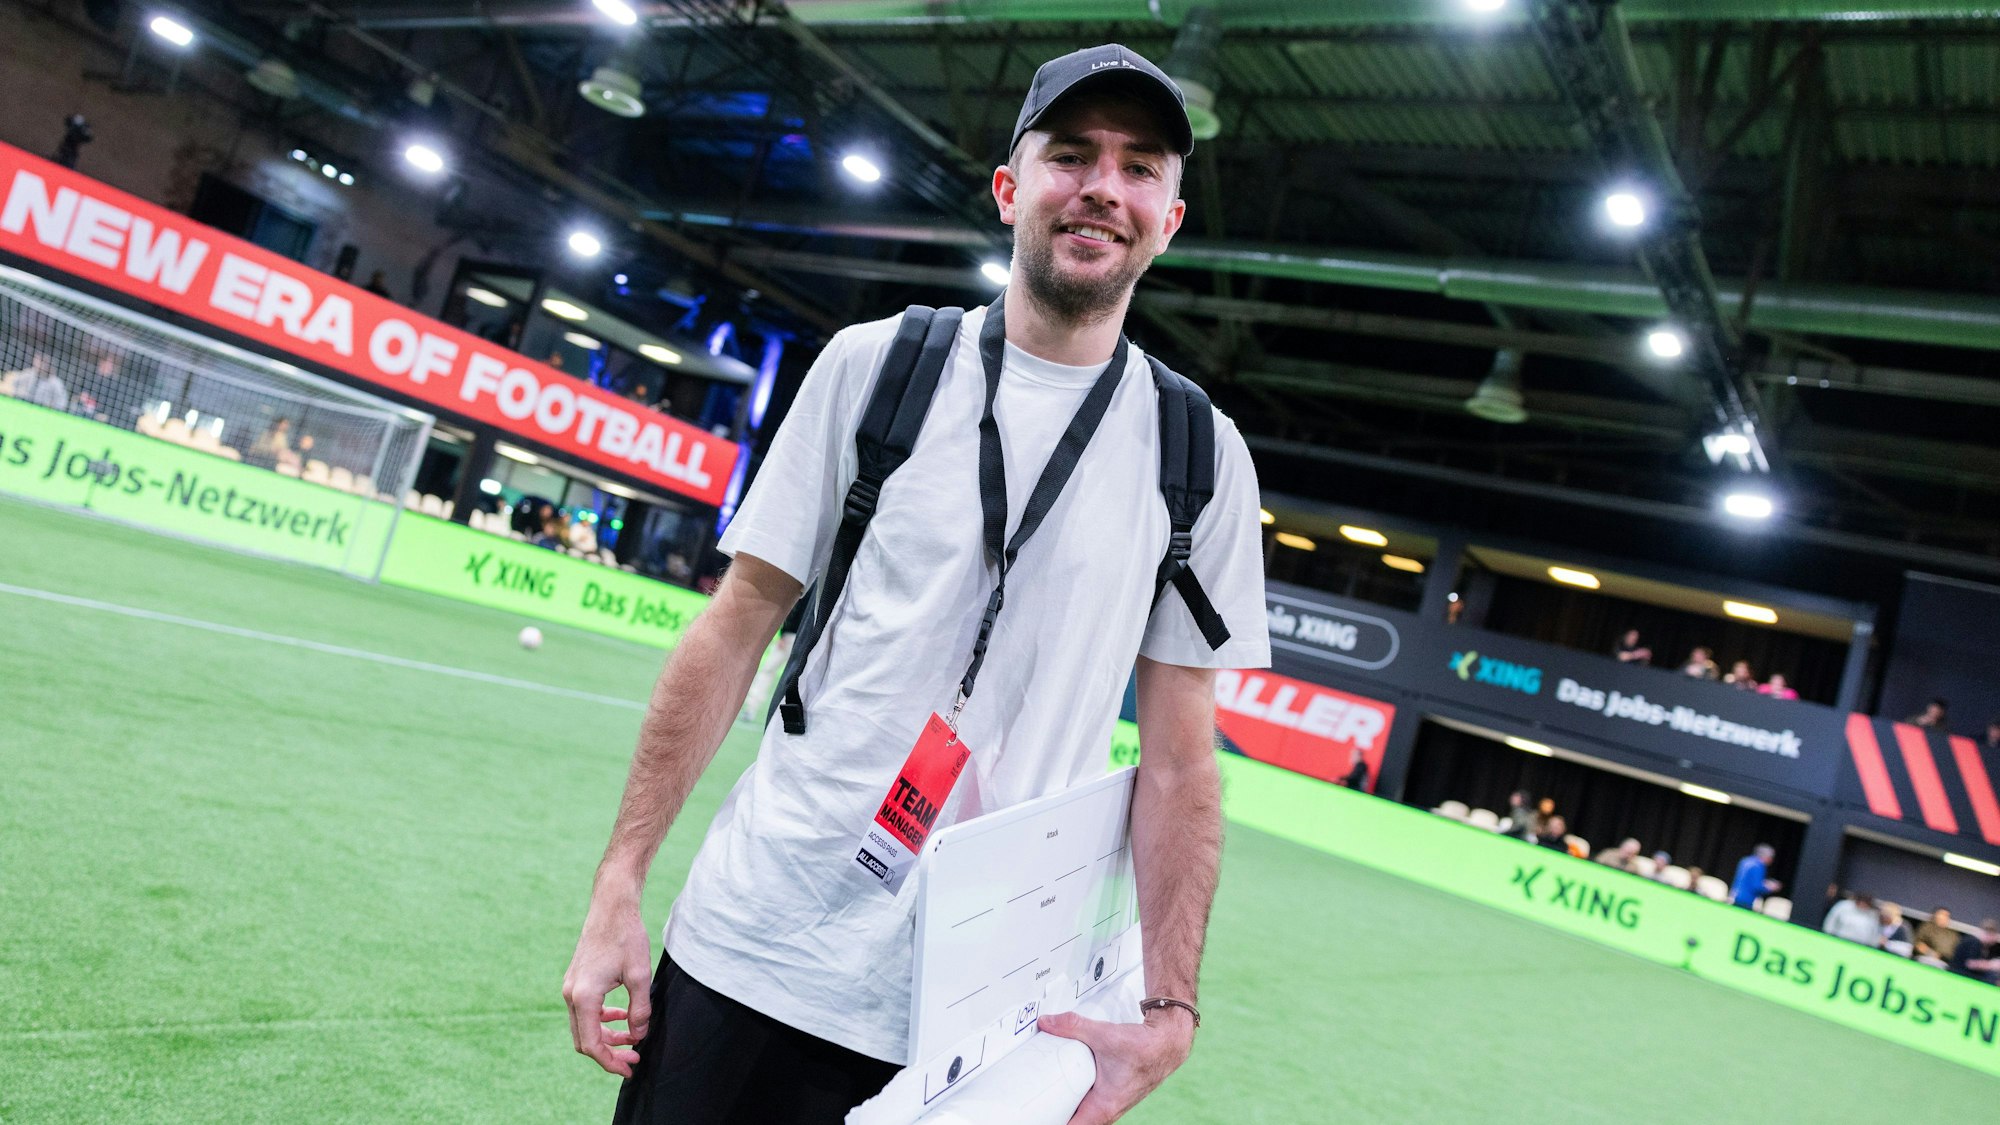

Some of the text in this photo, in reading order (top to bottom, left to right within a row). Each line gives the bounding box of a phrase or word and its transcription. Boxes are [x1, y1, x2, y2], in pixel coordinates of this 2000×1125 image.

[1091, 60, 1119, 70] Live
[0, 169, 713, 490] NEW ERA OF FOOTBALL
[493, 558, 556, 599] XING
[580, 581, 627, 618] Das
[1295, 614, 1359, 651] XING
[1474, 655, 1802, 760] XING Das Jobs-Netzwerk
[893, 776, 939, 831] TEAM
[868, 831, 898, 858] ACCESS PASS
[880, 803, 925, 847] MANAGER
[1046, 829, 1059, 839] Attack
[858, 851, 887, 876] ALL ACCESS
[1551, 875, 1643, 929] XING
[1732, 932, 1815, 986] Das
[1035, 967, 1051, 981] Defense
